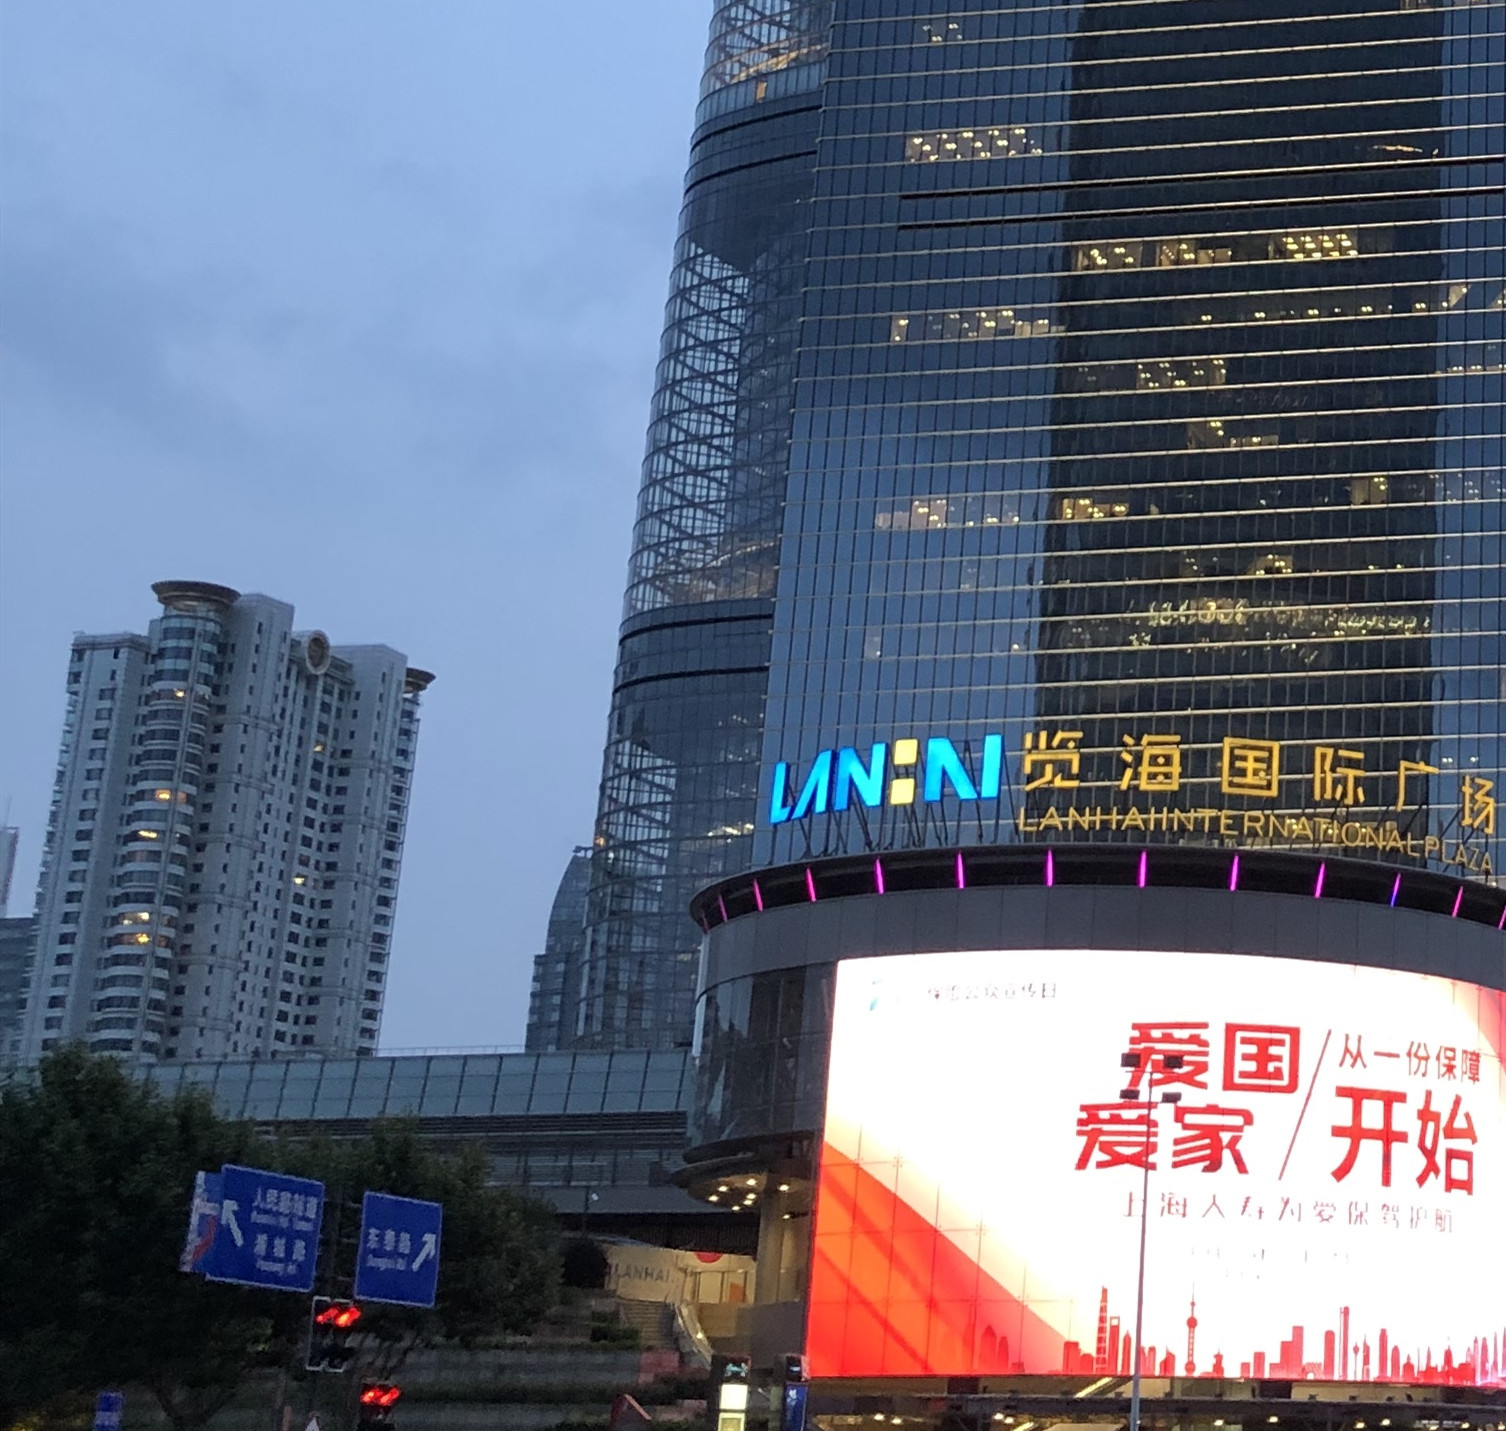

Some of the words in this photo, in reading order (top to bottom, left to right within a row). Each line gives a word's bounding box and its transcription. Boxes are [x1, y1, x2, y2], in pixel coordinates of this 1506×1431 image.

[1023, 729, 1496, 836] 览海国际广场
[1127, 1021, 1301, 1094] 爱国
[1339, 1033, 1482, 1086] 从一份保障
[1074, 1100, 1255, 1175] 爱家
[1330, 1085, 1479, 1196] 开始
